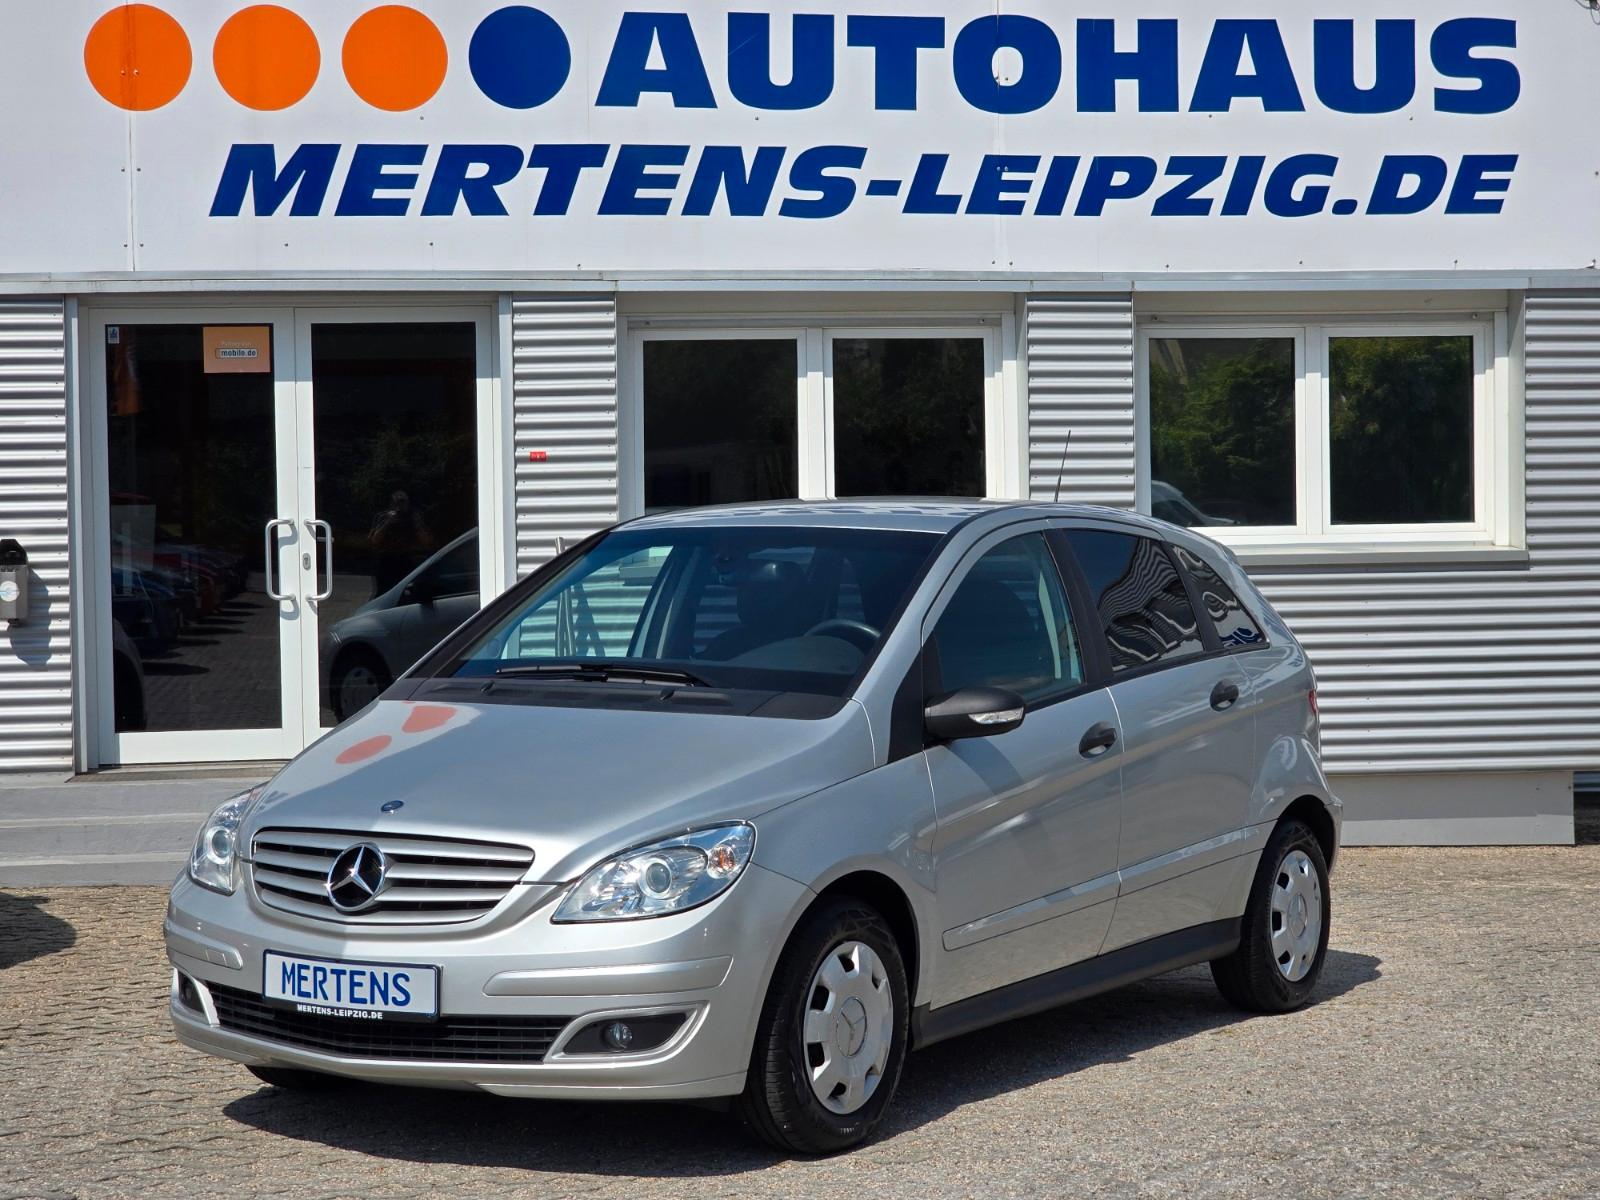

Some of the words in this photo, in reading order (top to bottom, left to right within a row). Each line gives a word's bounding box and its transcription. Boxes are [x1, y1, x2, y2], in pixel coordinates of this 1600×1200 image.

[595, 11, 1521, 115] AUTOHAUS
[209, 143, 1518, 219] MERTENS-LEIPZIG.DE
[221, 349, 257, 357] mobile.de
[281, 960, 411, 1007] MERTENS
[297, 1004, 384, 1020] MERTENS-LEIPZIG.DE
